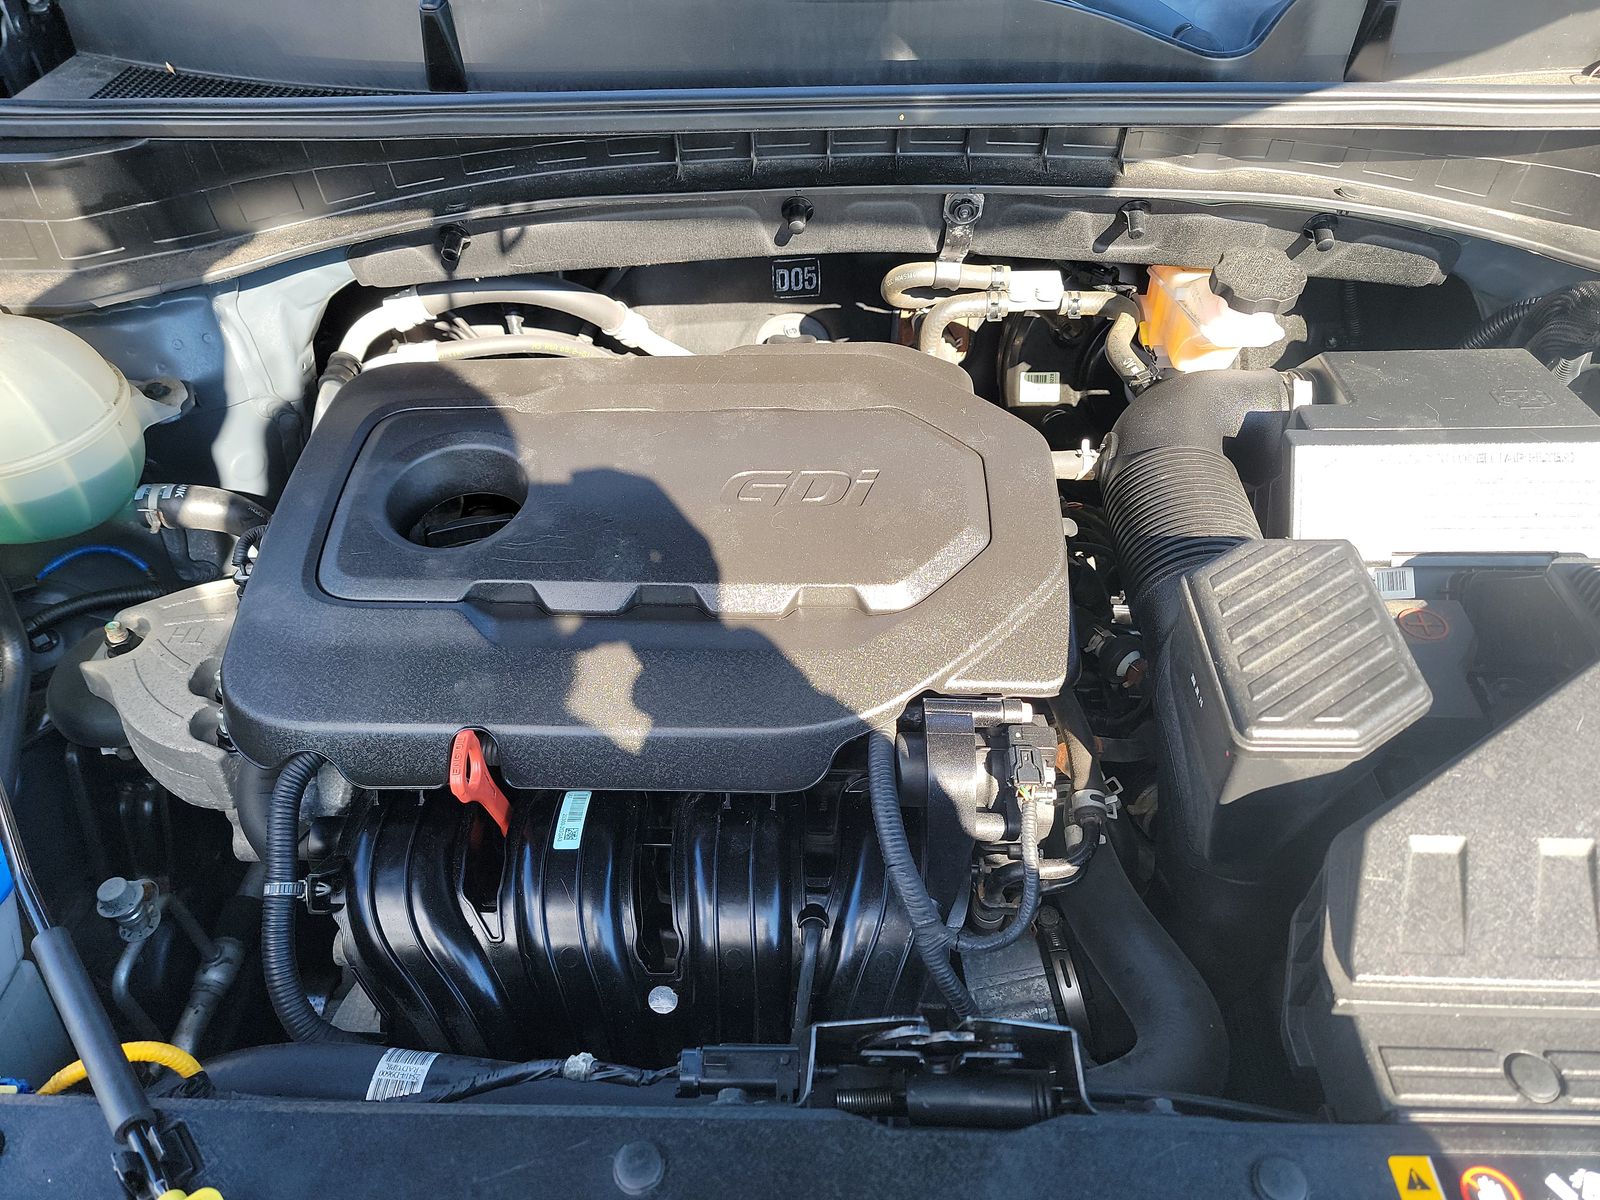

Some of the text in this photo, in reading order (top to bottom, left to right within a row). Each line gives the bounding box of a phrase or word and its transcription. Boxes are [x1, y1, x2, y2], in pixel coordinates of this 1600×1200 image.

[720, 469, 881, 507] GDi
[451, 736, 465, 775] ENG OIL
